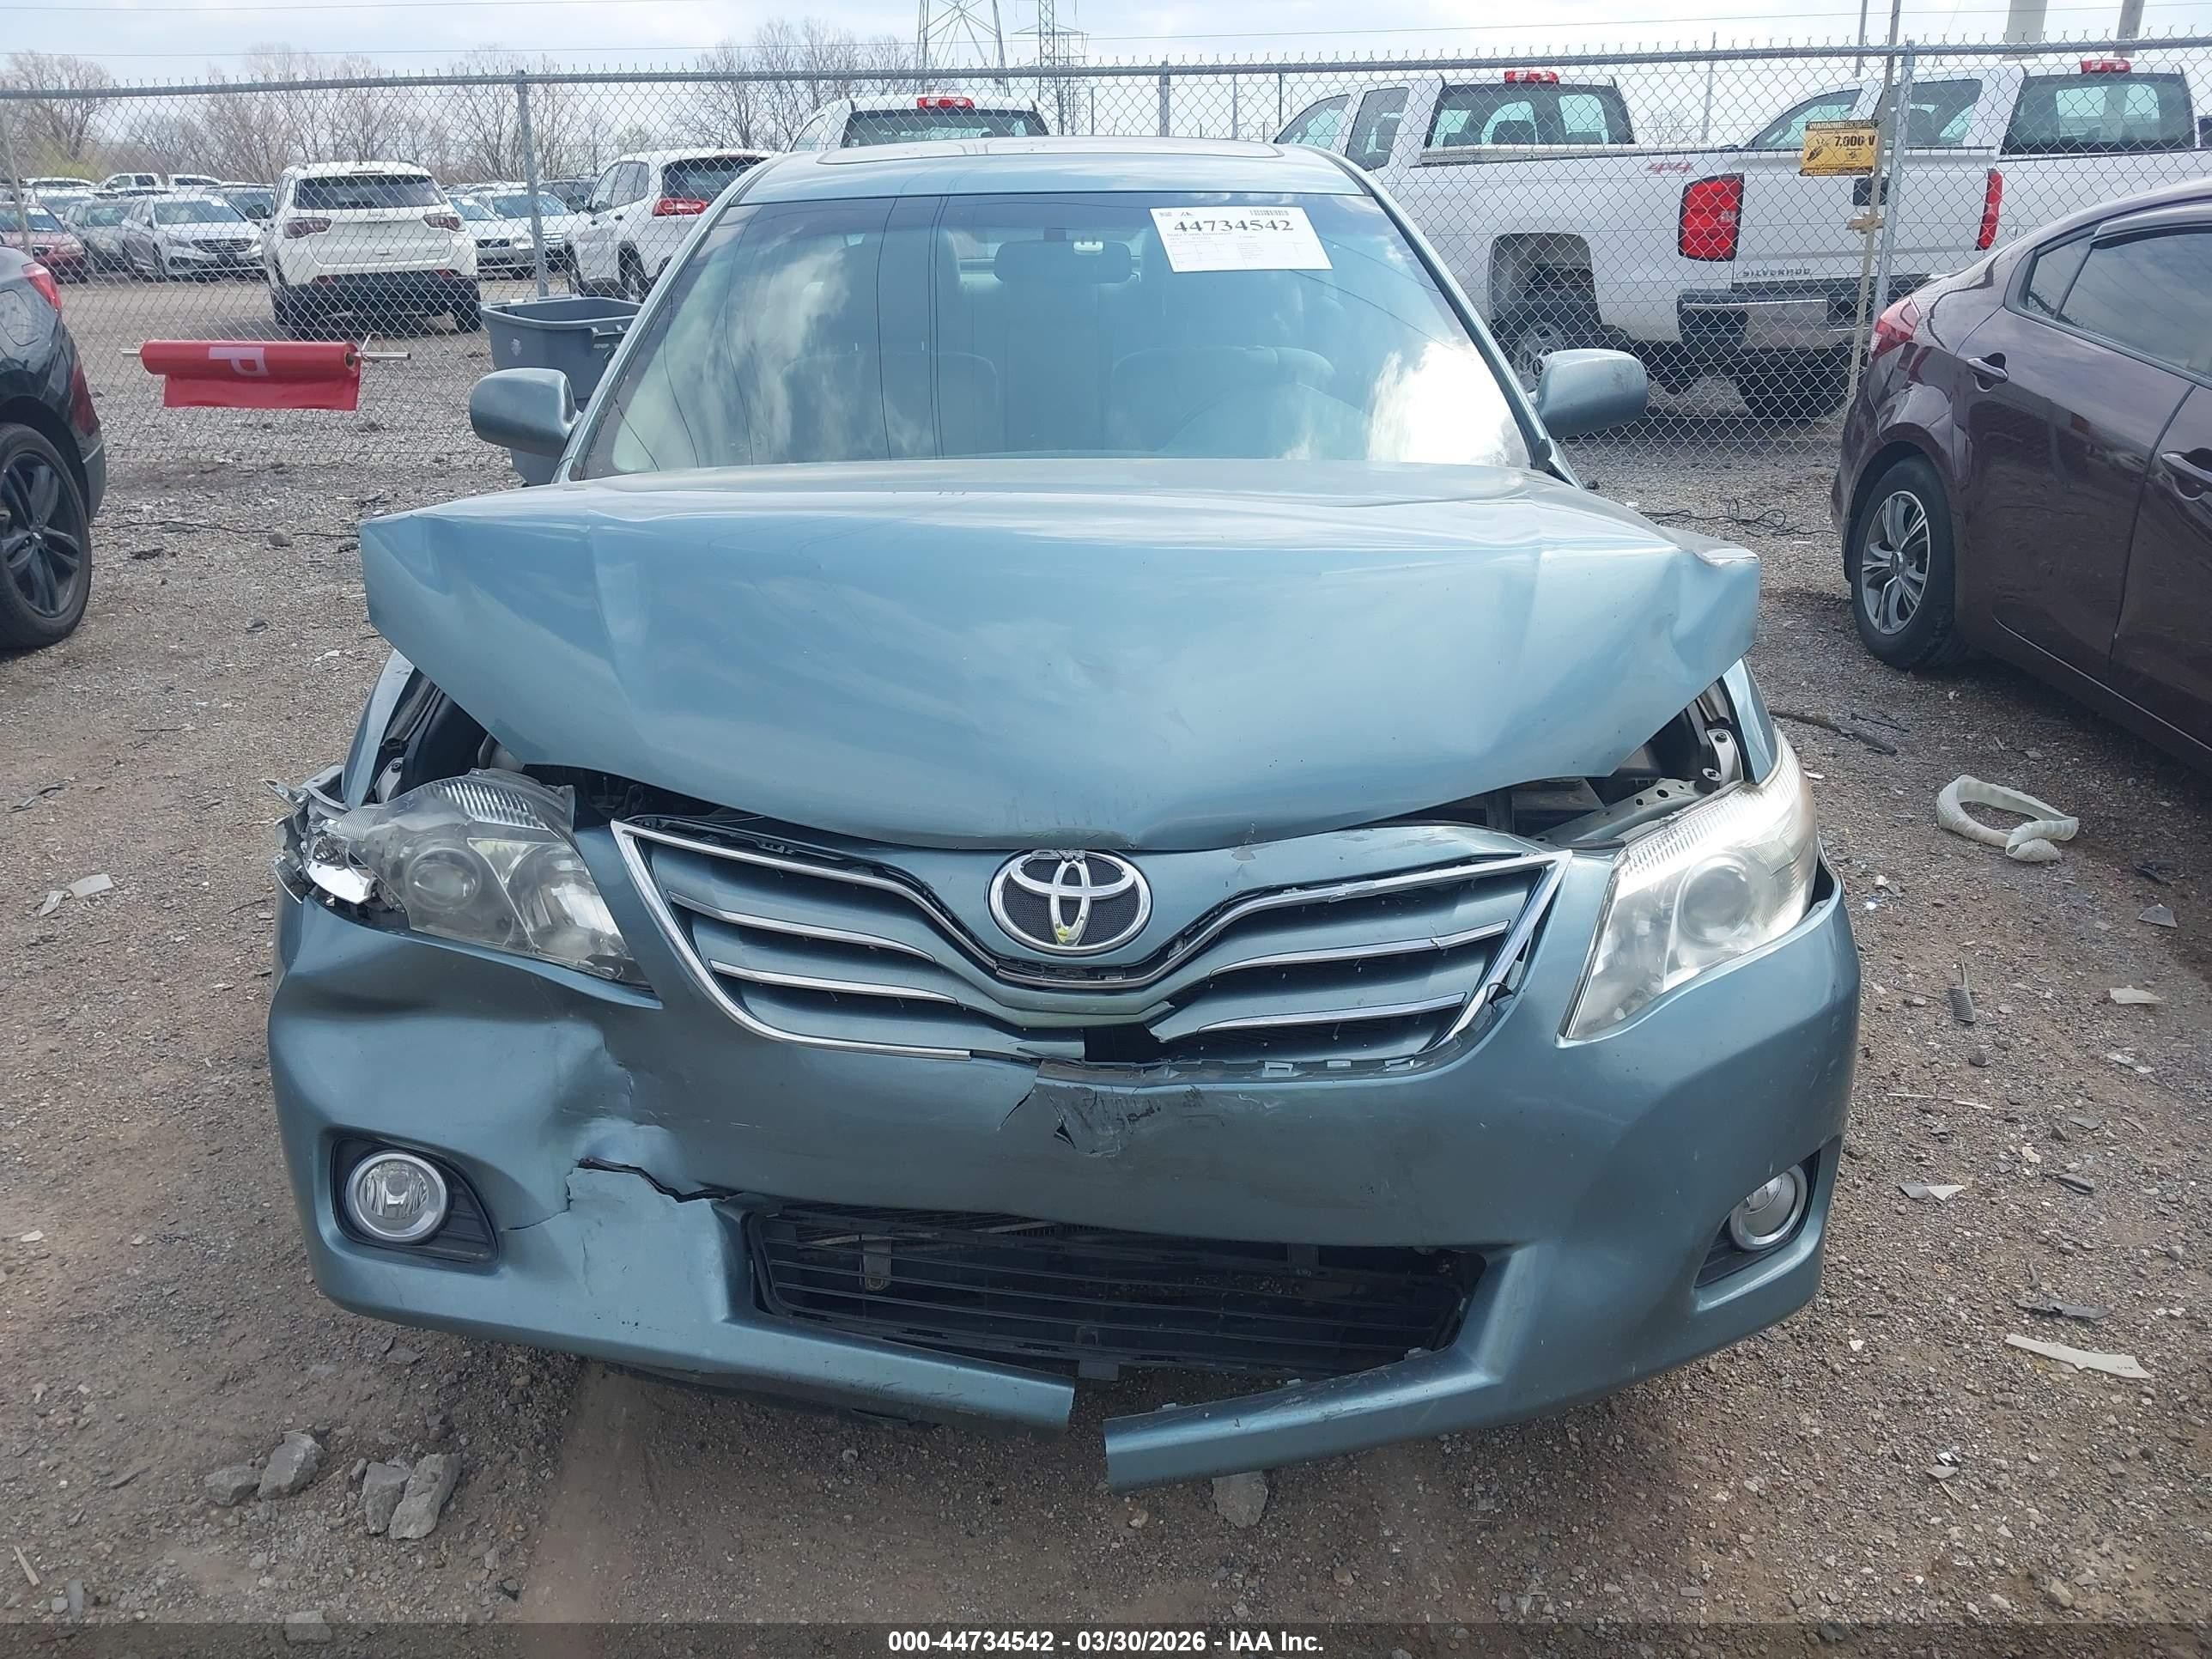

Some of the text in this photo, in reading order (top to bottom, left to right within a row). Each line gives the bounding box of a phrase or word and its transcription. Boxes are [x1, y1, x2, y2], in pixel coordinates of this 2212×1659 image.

[1868, 135, 1876, 146] V
[1174, 219, 1294, 233] 44734542
[1741, 268, 1811, 277] SILVERADO
